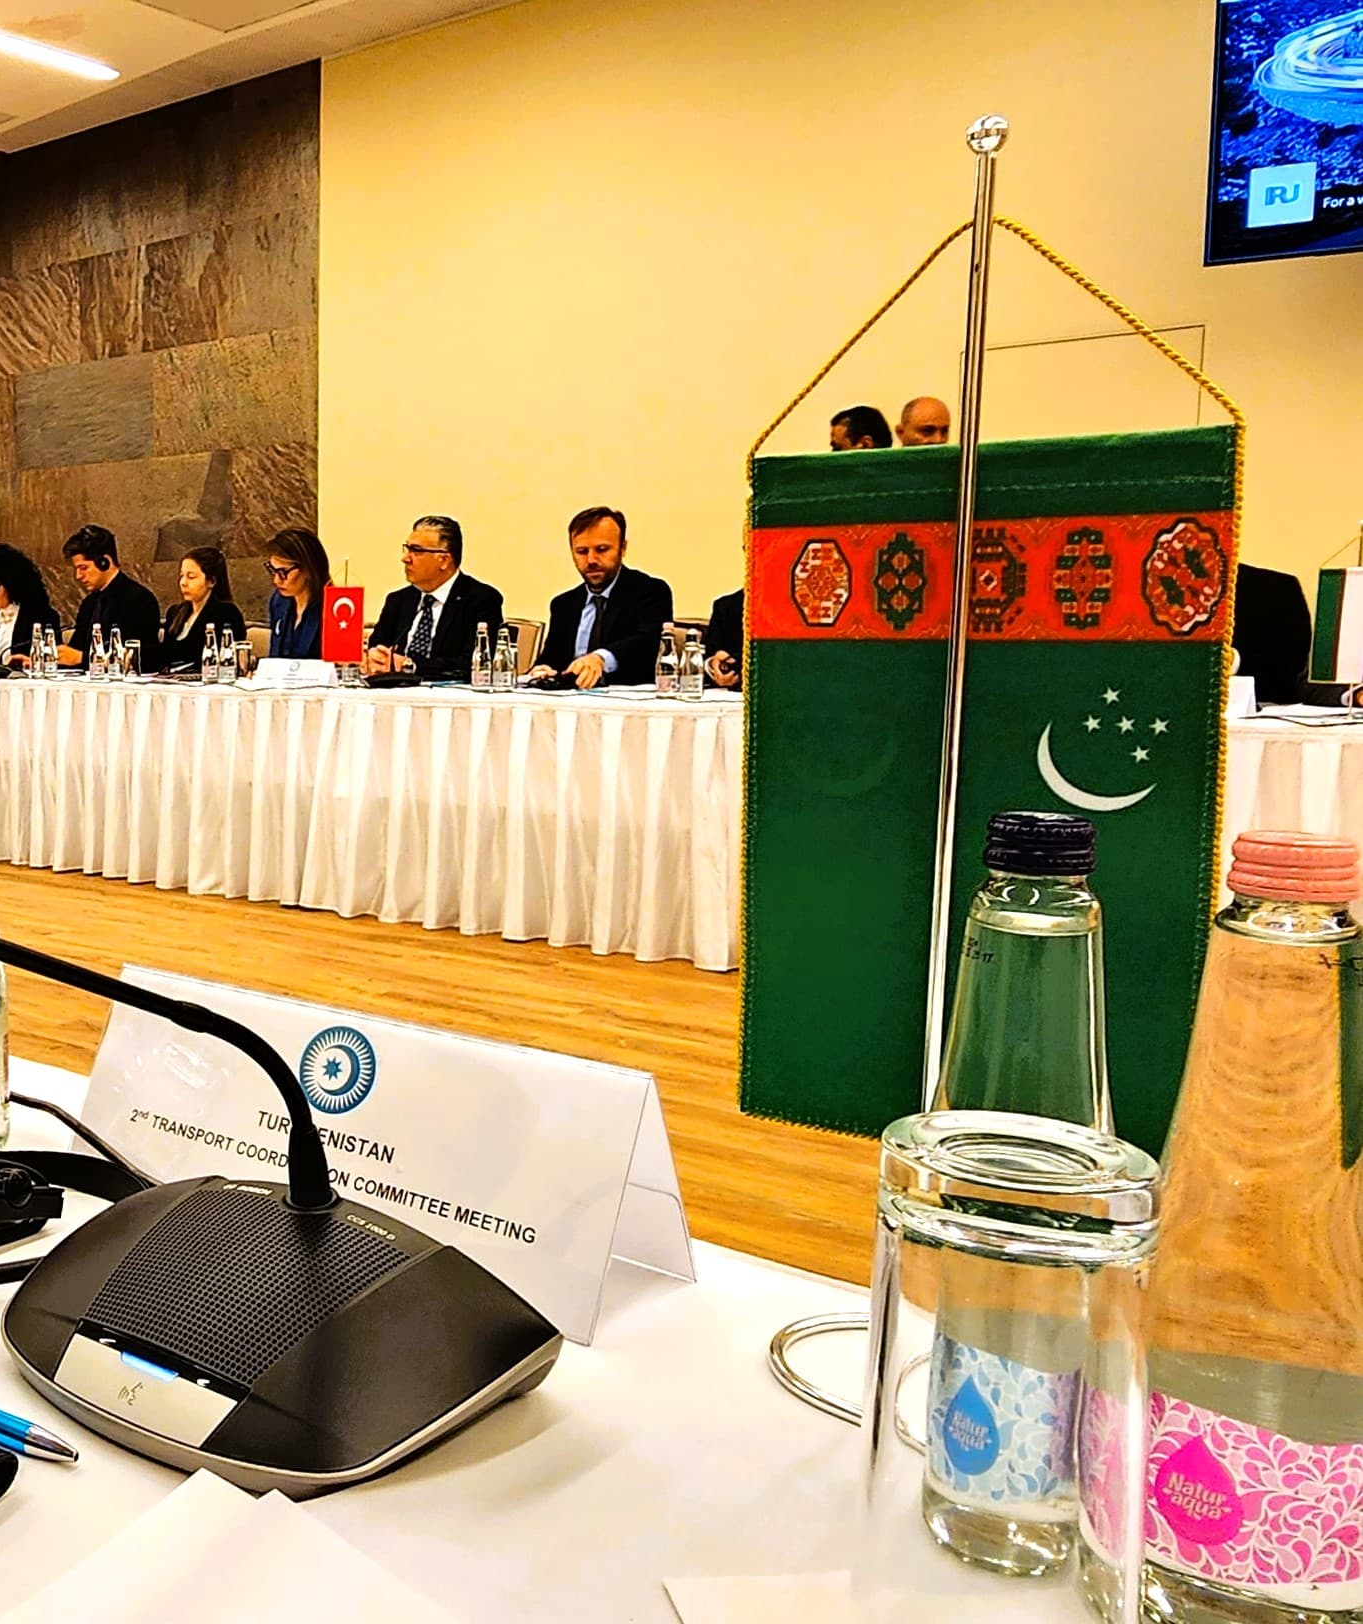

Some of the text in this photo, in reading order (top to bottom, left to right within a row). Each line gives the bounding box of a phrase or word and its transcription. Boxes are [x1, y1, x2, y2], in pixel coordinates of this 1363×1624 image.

[1323, 196, 1345, 208] For
[257, 1110, 395, 1163] TURENISTAN
[129, 1109, 537, 1244] 2nd TRANSPORT COORDON COMMITTEE MEETING
[1168, 1471, 1227, 1507] Natur
[1171, 1491, 1222, 1520] aqua
